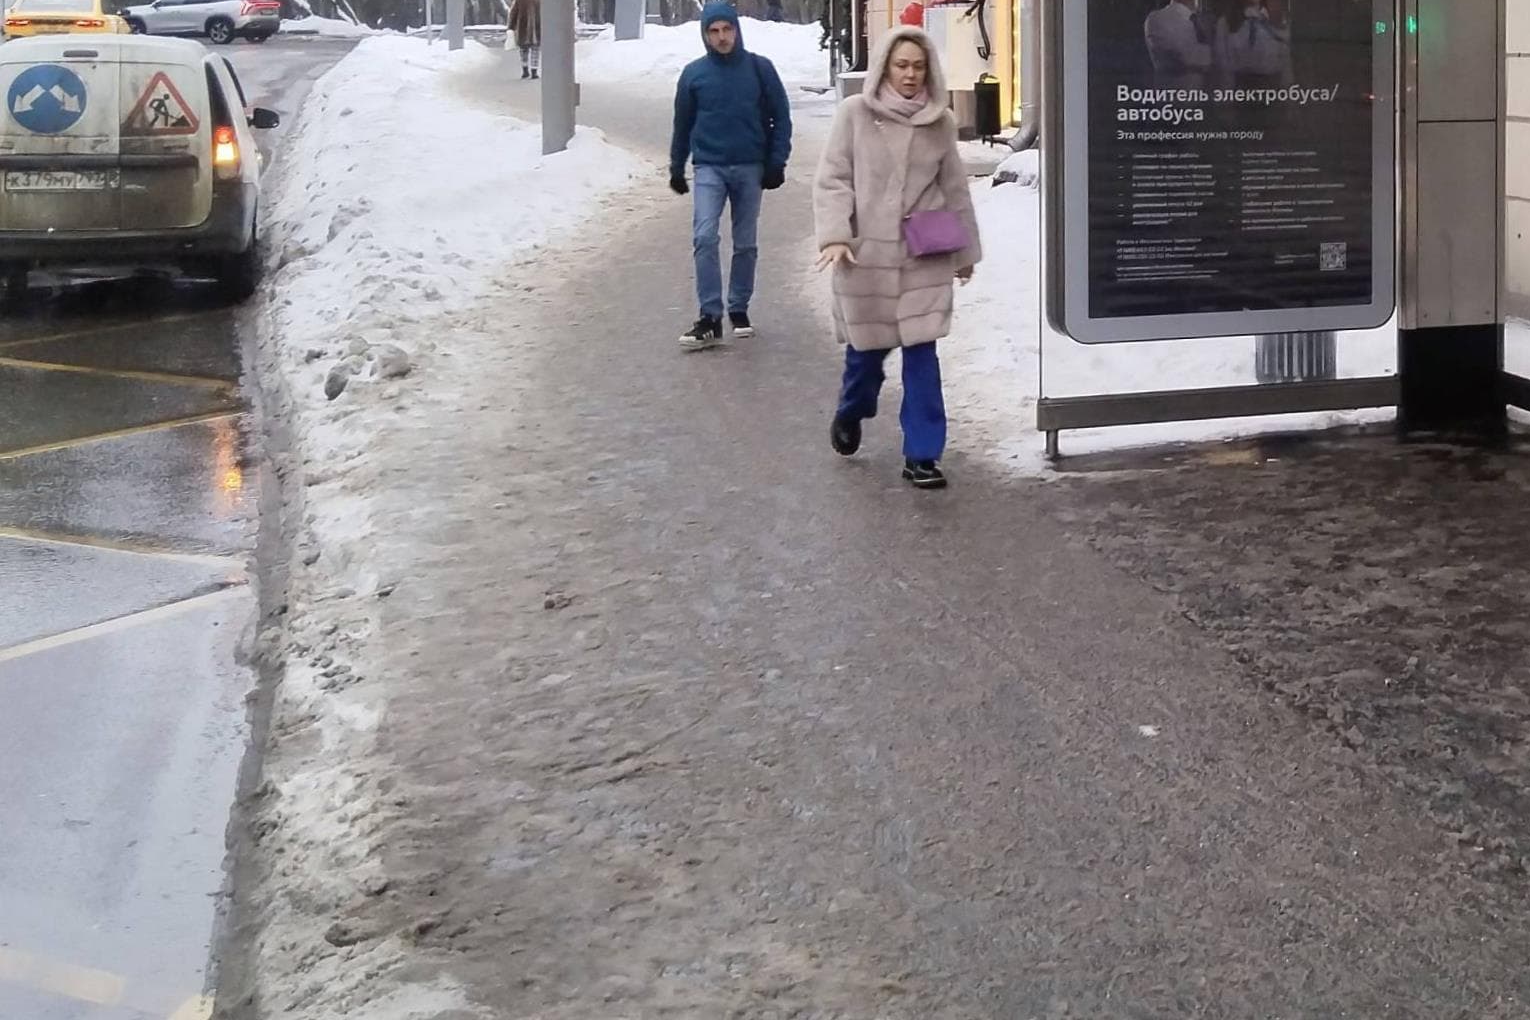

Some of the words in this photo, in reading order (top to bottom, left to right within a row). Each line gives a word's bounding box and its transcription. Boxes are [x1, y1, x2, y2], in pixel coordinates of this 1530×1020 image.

[1117, 85, 1209, 104] Водитель
[1213, 84, 1339, 105] электробуса/
[1117, 104, 1204, 125] автобуса
[1117, 130, 1135, 140] Эта
[1137, 130, 1194, 141] профессия
[1196, 130, 1228, 141] нужна
[1230, 130, 1264, 141] городу
